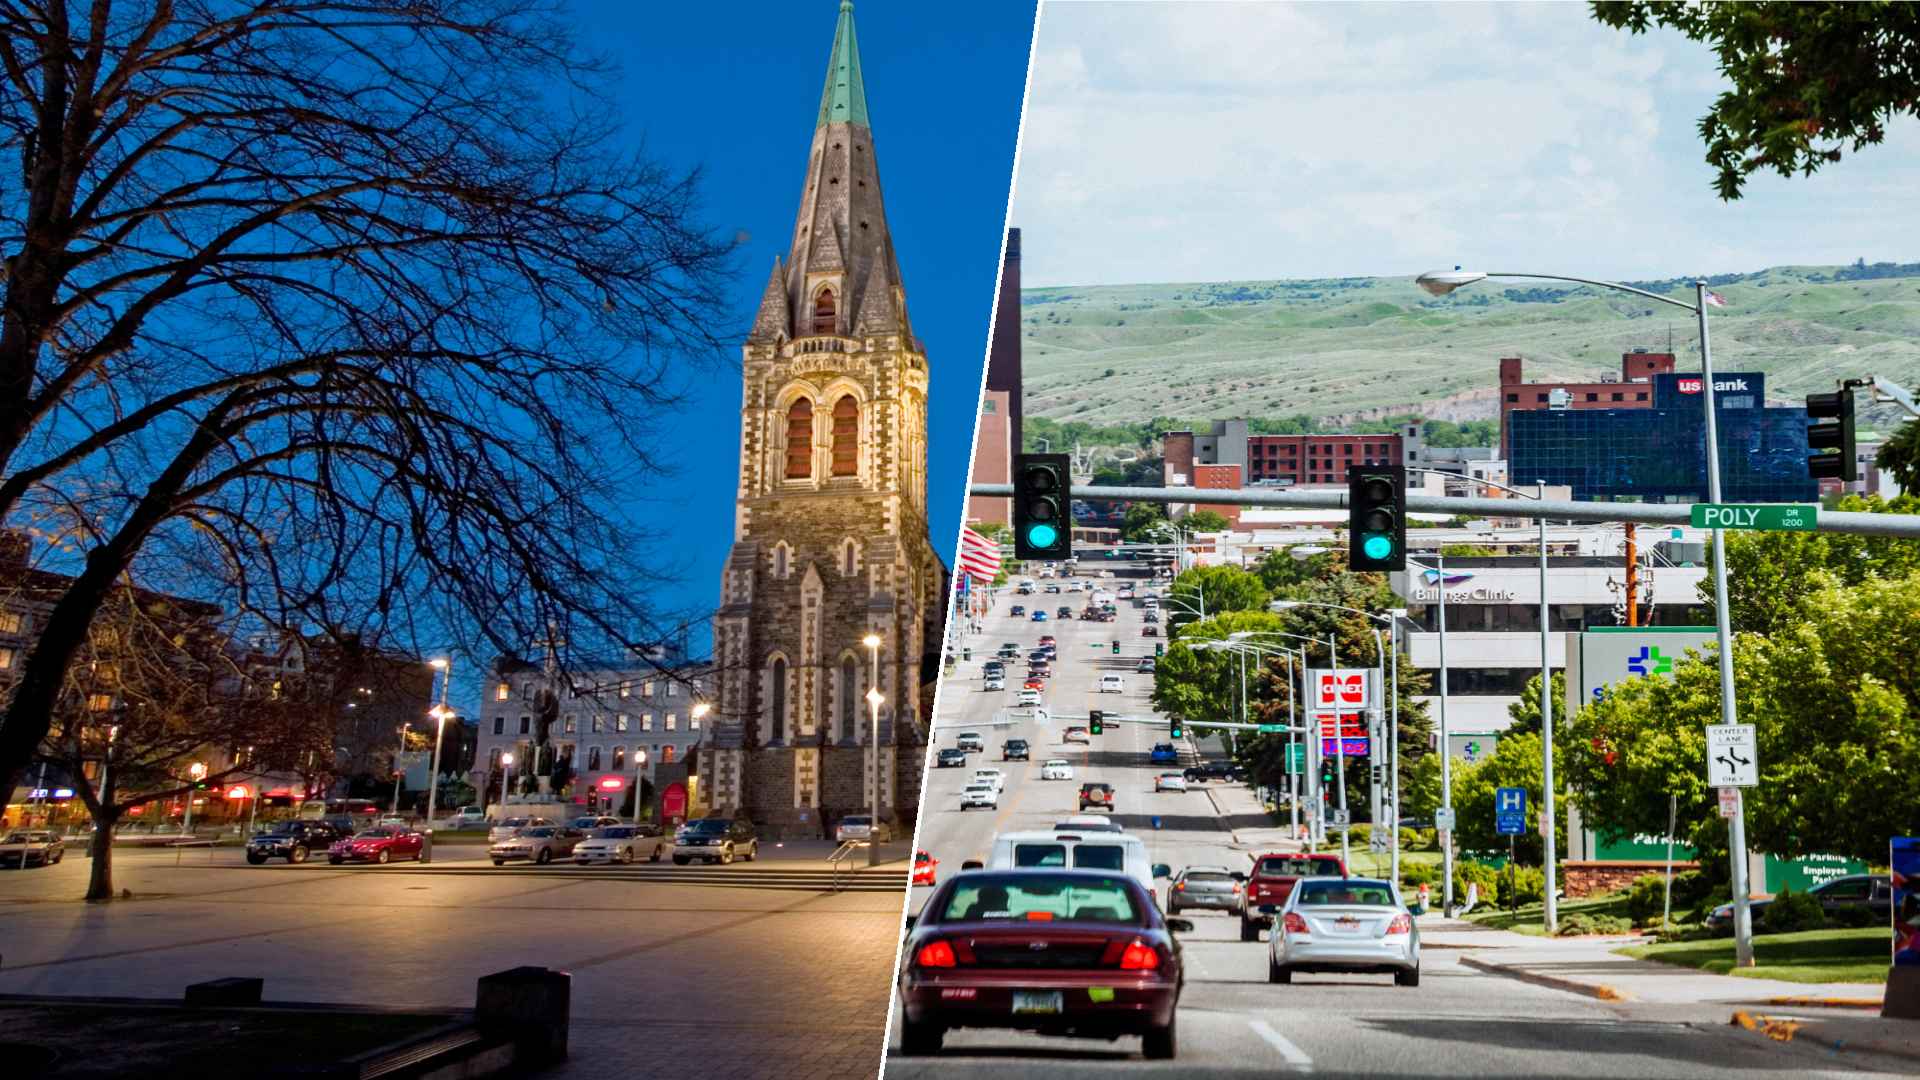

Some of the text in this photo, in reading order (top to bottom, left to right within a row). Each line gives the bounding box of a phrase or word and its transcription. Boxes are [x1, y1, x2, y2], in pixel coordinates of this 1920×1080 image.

[1679, 378, 1750, 392] us ank
[1704, 507, 1760, 526] POLY
[1785, 508, 1799, 517] DR
[1782, 518, 1804, 528] 1200
[1415, 585, 1515, 604] Billngs Clinic
[1502, 791, 1520, 810] H
[1802, 865, 1848, 877] Employee
